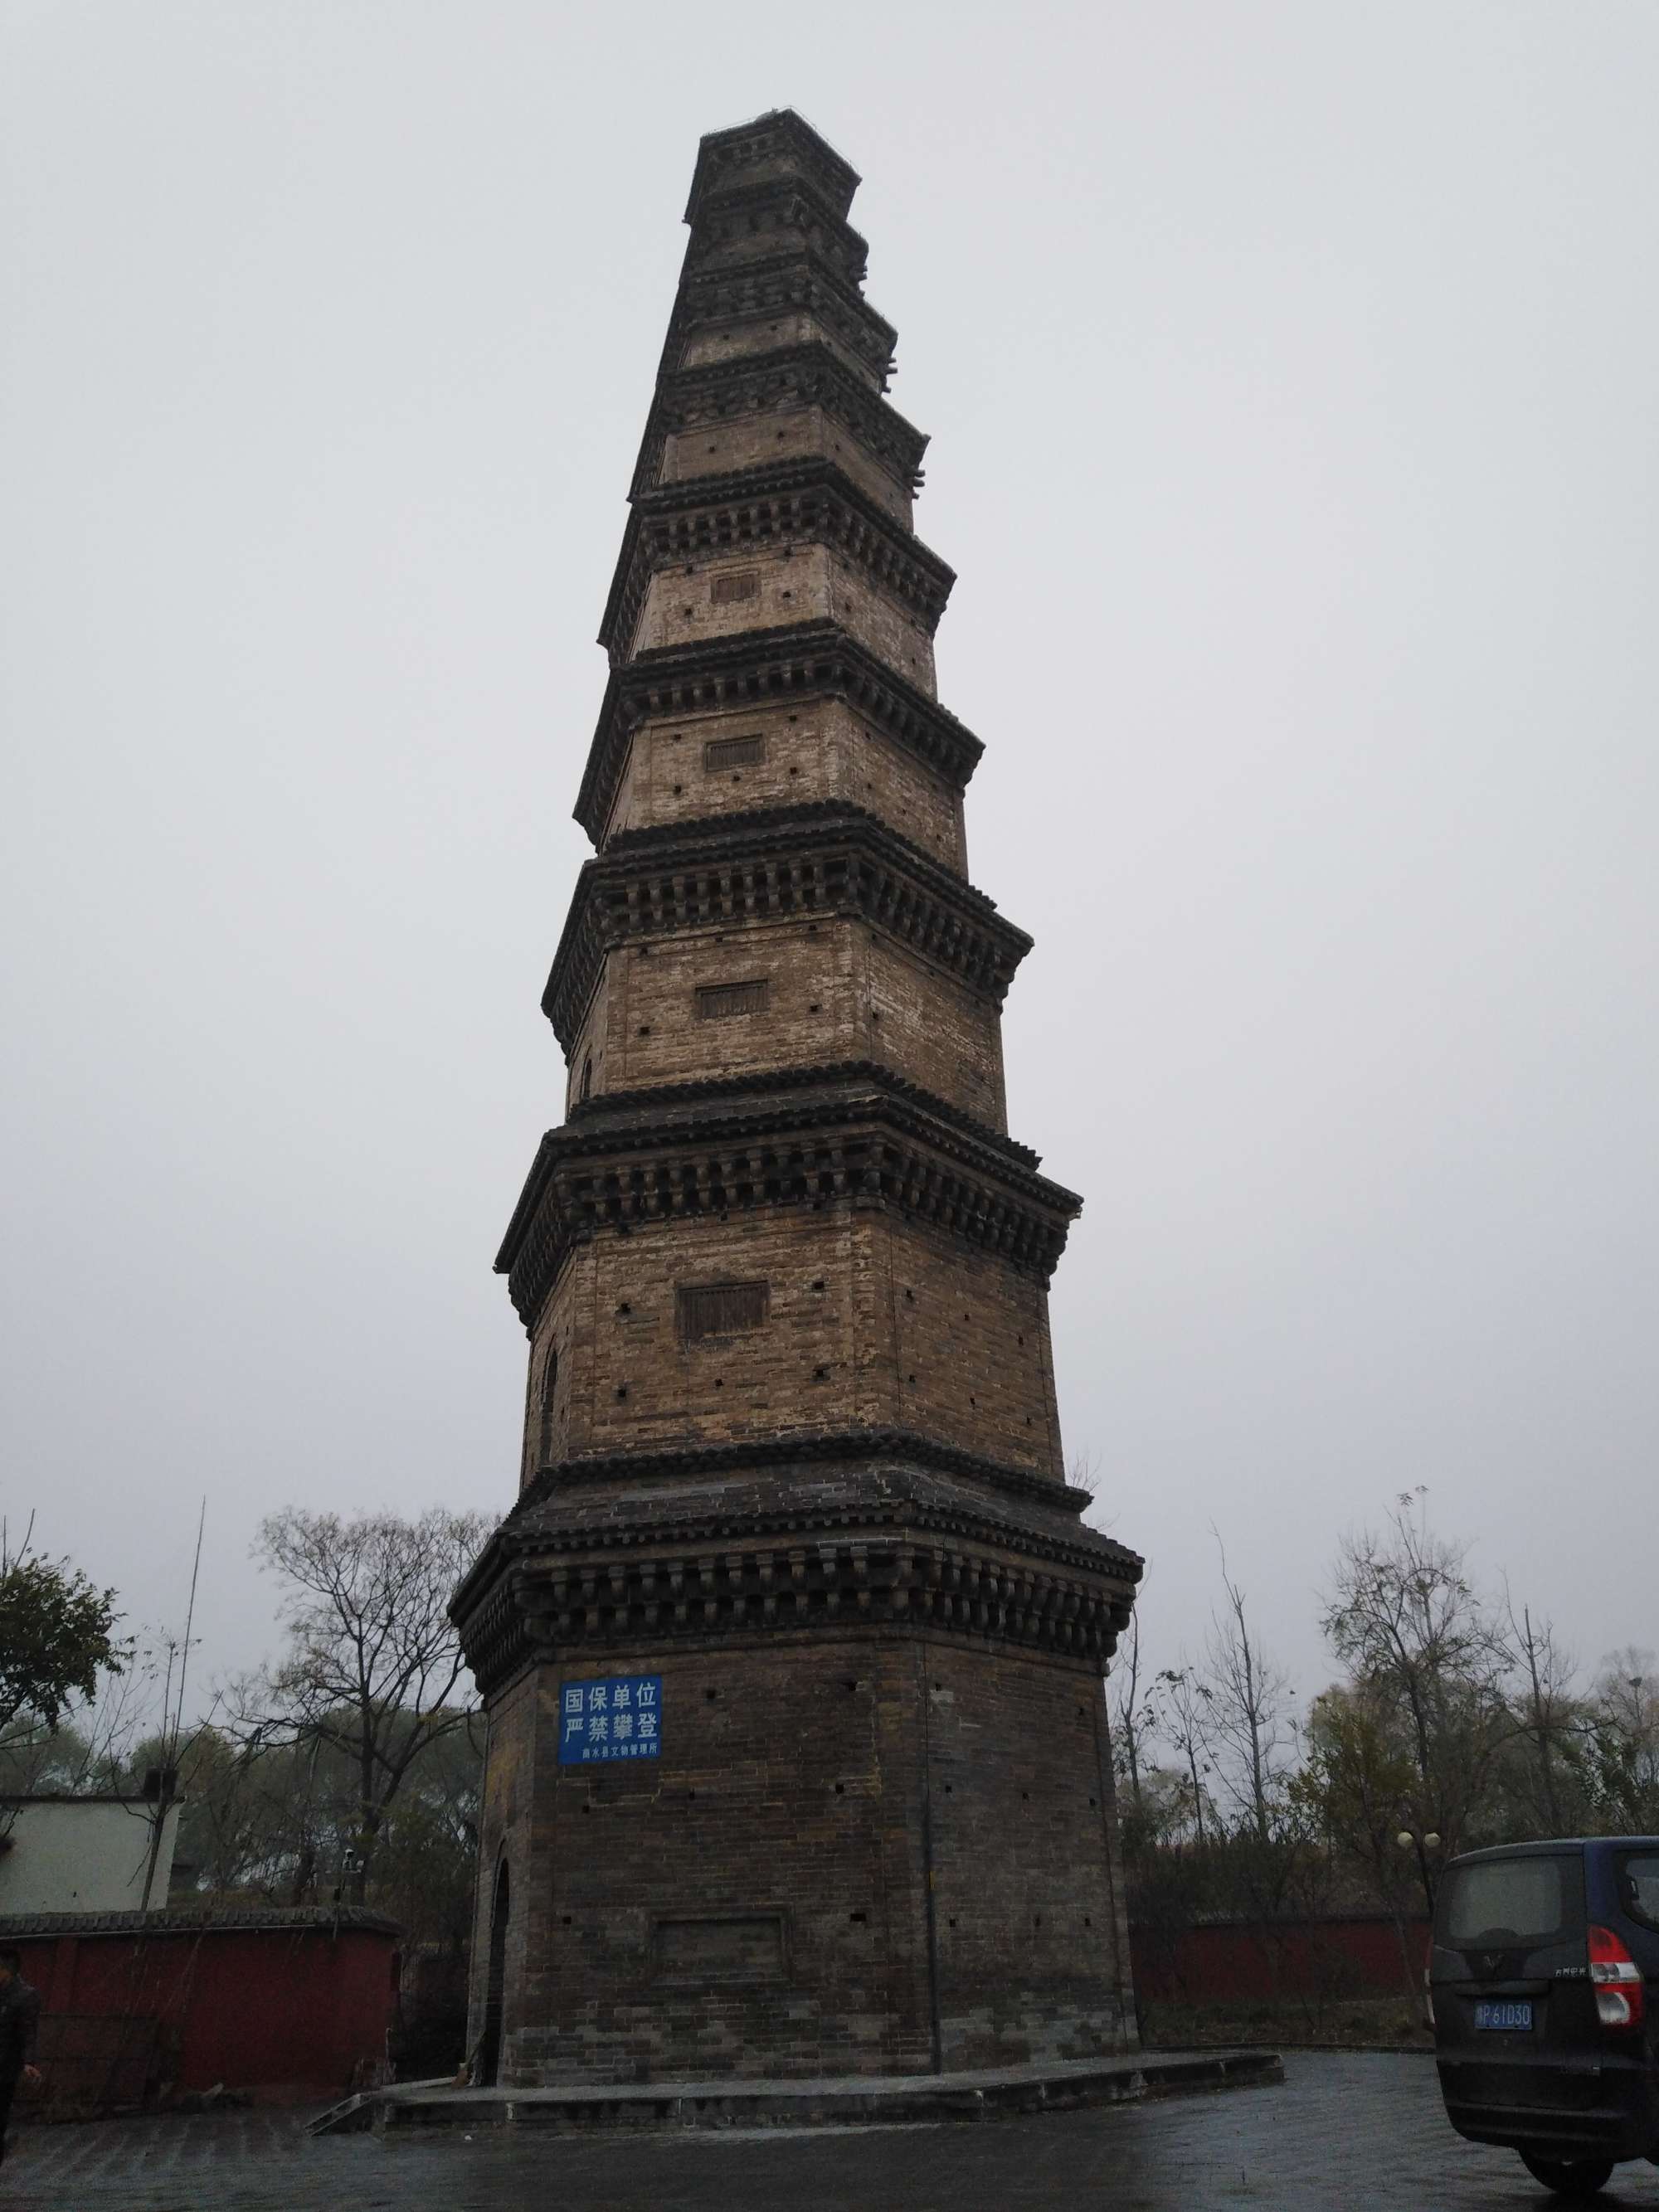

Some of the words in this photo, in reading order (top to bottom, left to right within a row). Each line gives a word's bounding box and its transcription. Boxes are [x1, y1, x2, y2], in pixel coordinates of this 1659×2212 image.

[565, 1682, 656, 1713] 国保单位
[565, 1713, 657, 1743] 严禁攀登
